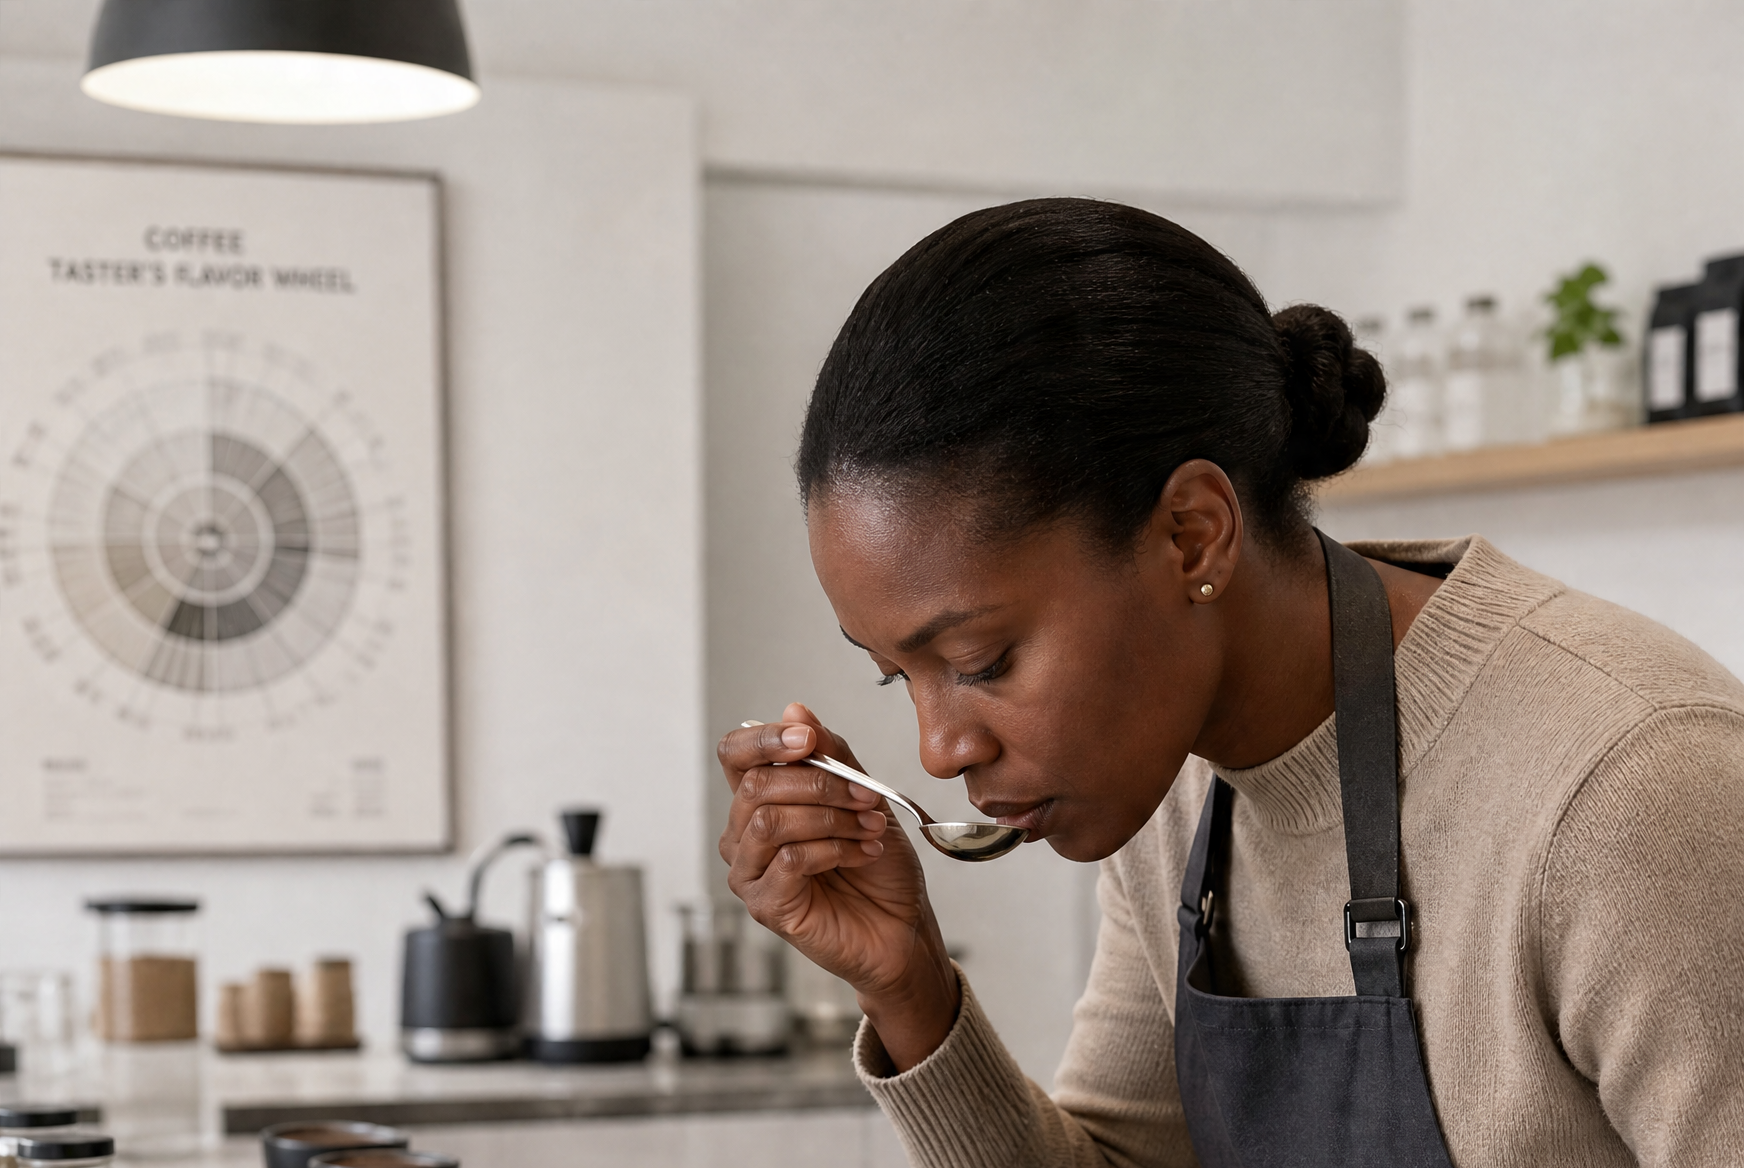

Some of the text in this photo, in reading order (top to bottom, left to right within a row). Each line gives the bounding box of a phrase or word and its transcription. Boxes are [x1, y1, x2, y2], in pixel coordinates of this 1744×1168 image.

[144, 226, 245, 254] COFFEE
[49, 259, 357, 294] TASTER'S FLAVOR WHEEL
